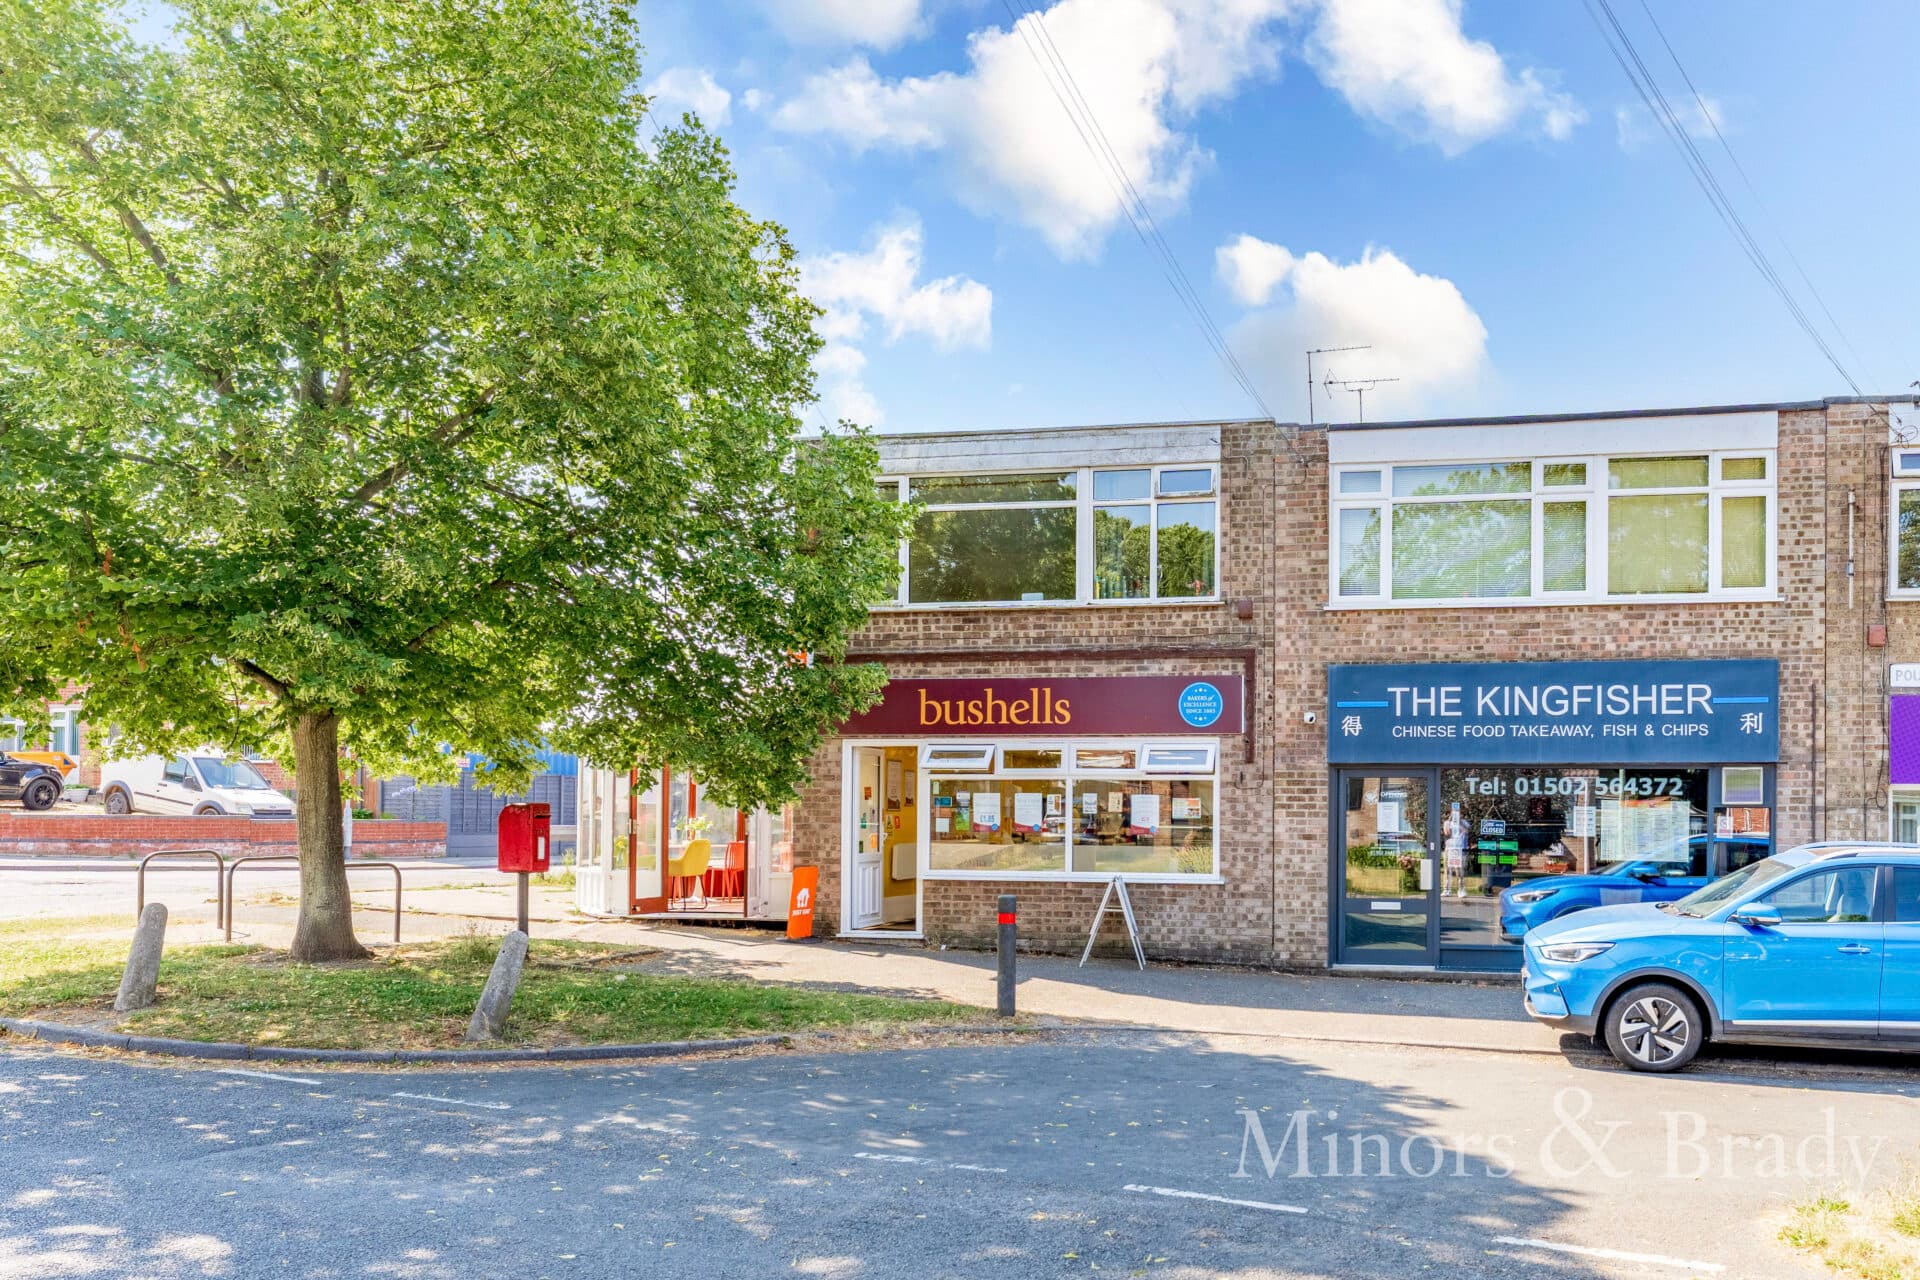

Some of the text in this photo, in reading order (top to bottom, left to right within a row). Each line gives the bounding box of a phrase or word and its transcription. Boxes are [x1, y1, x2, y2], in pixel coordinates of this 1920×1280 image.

[918, 687, 1071, 725] bushells
[1387, 684, 1714, 717] THE KINGFISHER
[1341, 715, 1363, 737] 得
[1392, 724, 1709, 739] CHINESE FOOD TAKEAWAY, FISH & CHIPS
[1740, 712, 1763, 735] 利
[1465, 776, 1684, 795] Tel: 01502 564372
[1482, 826, 1504, 834] CLOSED
